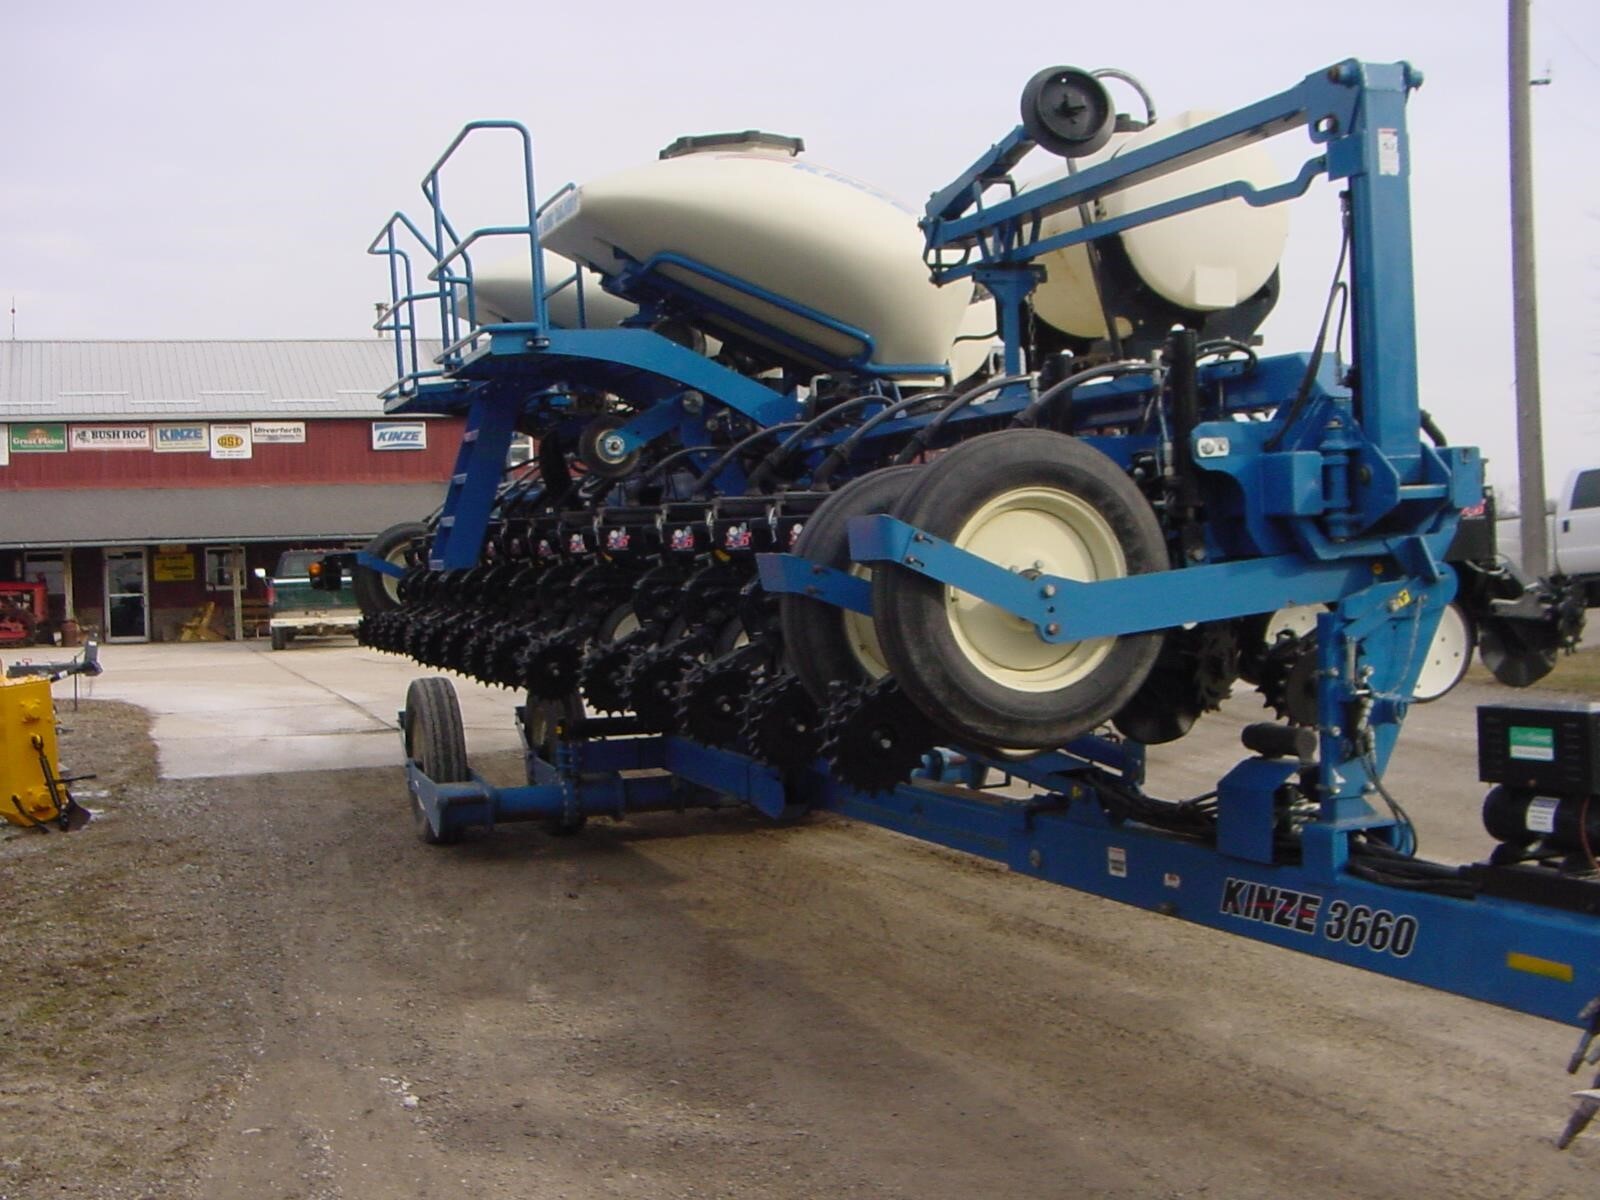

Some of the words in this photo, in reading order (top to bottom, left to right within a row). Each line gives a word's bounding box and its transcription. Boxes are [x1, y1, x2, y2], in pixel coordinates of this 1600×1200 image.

[91, 430, 120, 439] BUSH
[122, 430, 146, 439] HOG
[159, 428, 203, 441] KINZE
[377, 431, 421, 441] KINZE
[1219, 877, 1323, 935] KINZE
[1324, 900, 1419, 958] 3660
